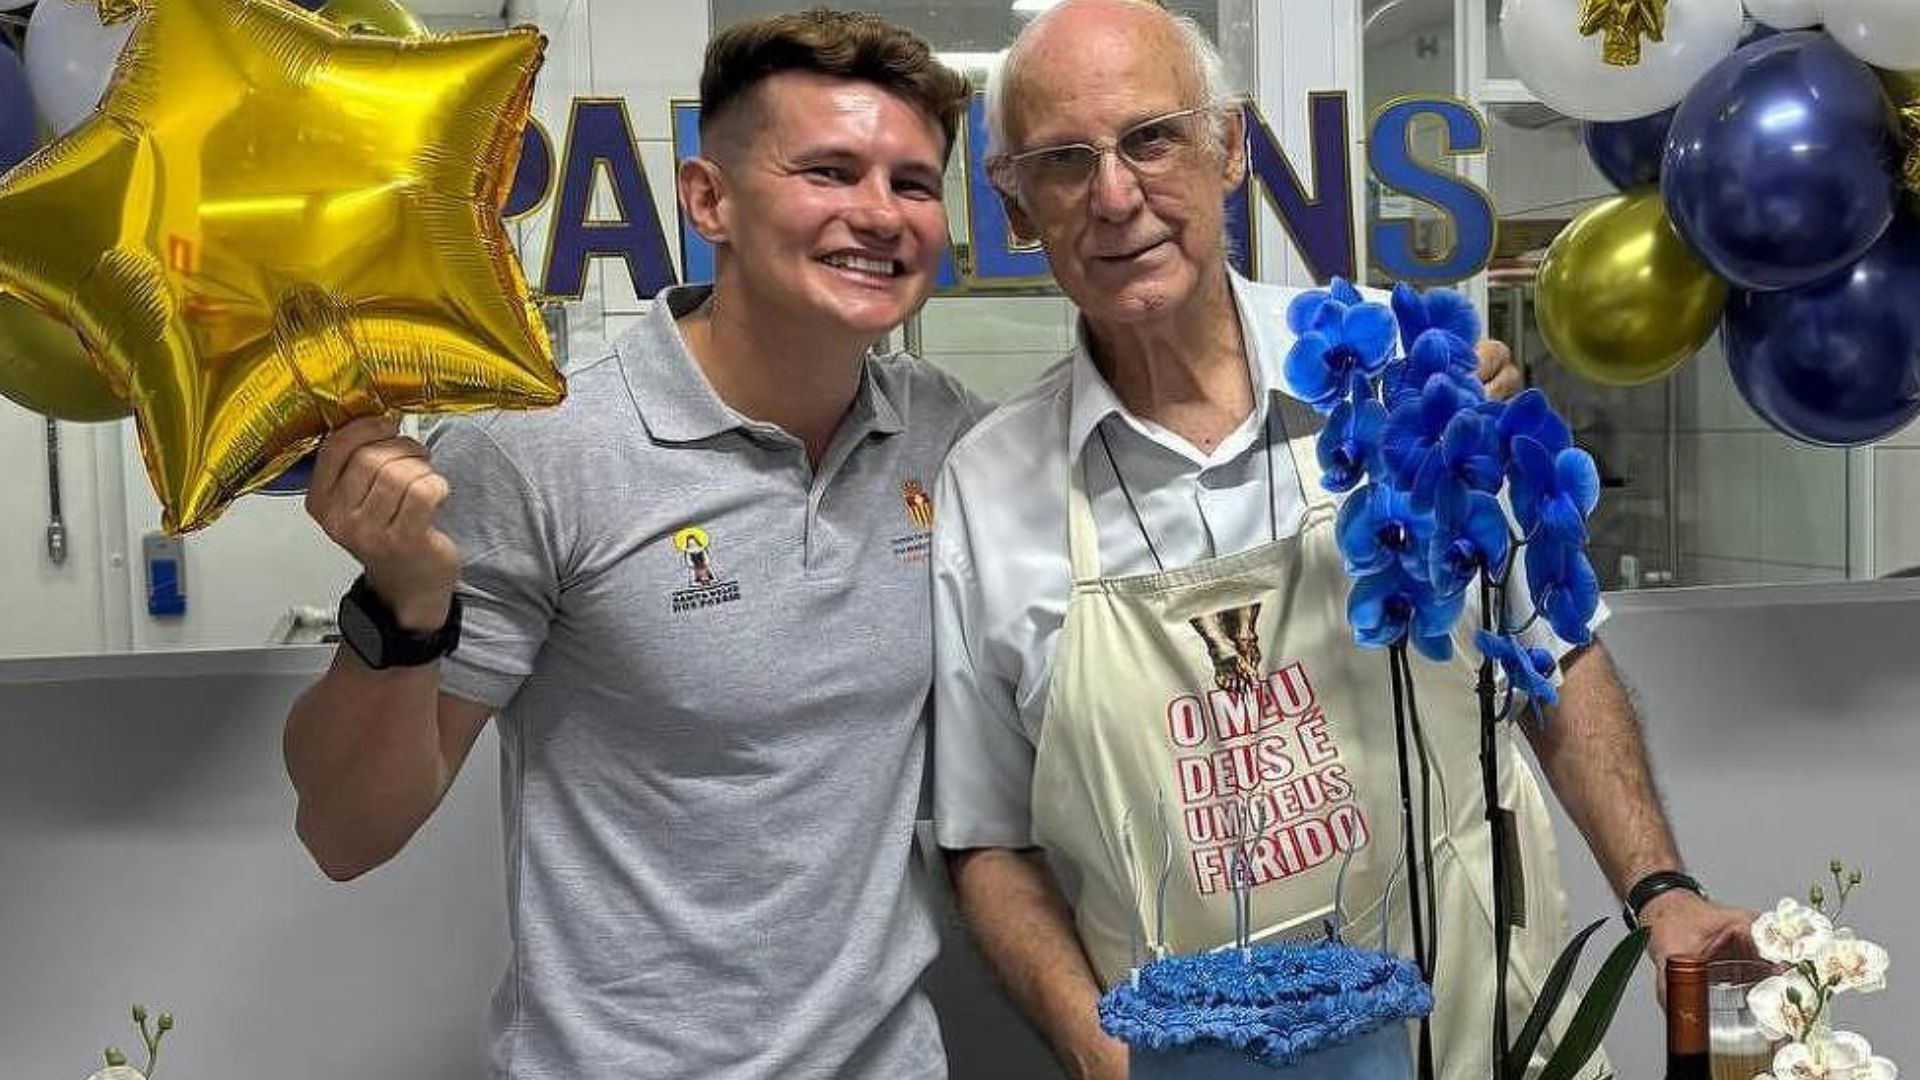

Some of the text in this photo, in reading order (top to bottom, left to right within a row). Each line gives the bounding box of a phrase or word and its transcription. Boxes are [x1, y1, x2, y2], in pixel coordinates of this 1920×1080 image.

[1168, 661, 1314, 748] O MEU
[1178, 704, 1338, 804] DEUS É
[1185, 764, 1354, 845] UM DEUS
